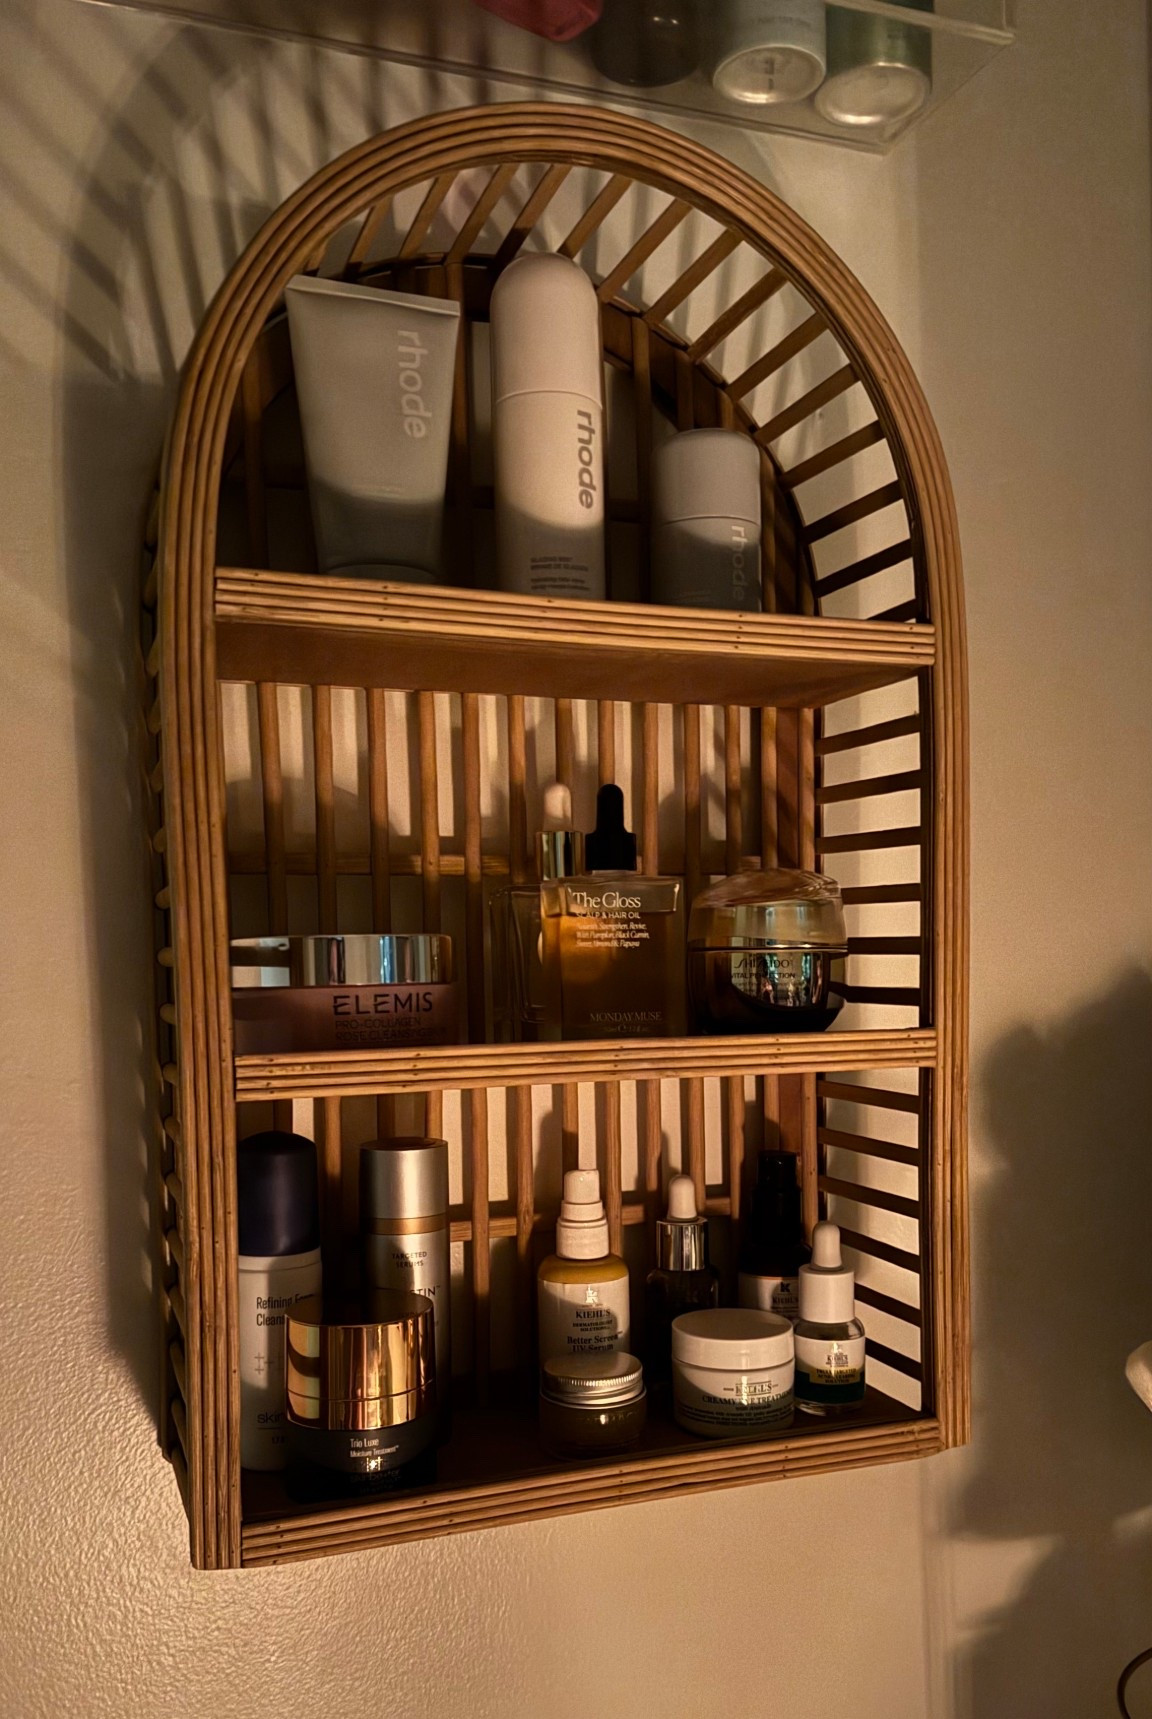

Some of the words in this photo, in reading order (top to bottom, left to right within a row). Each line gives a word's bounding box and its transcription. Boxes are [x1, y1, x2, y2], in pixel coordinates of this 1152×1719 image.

[397, 330, 432, 439] rhode
[577, 409, 597, 510] rhode
[731, 525, 748, 601] rhode
[572, 891, 601, 908] The
[602, 891, 642, 908] Gloss
[628, 911, 641, 919] OIL
[333, 992, 433, 1016] ELEMIS
[392, 1251, 428, 1259] TARGETED
[256, 1296, 293, 1310] Refining
[567, 1335, 593, 1345] Better
[350, 1438, 363, 1449] Trio
[364, 1437, 380, 1448] Luxe
